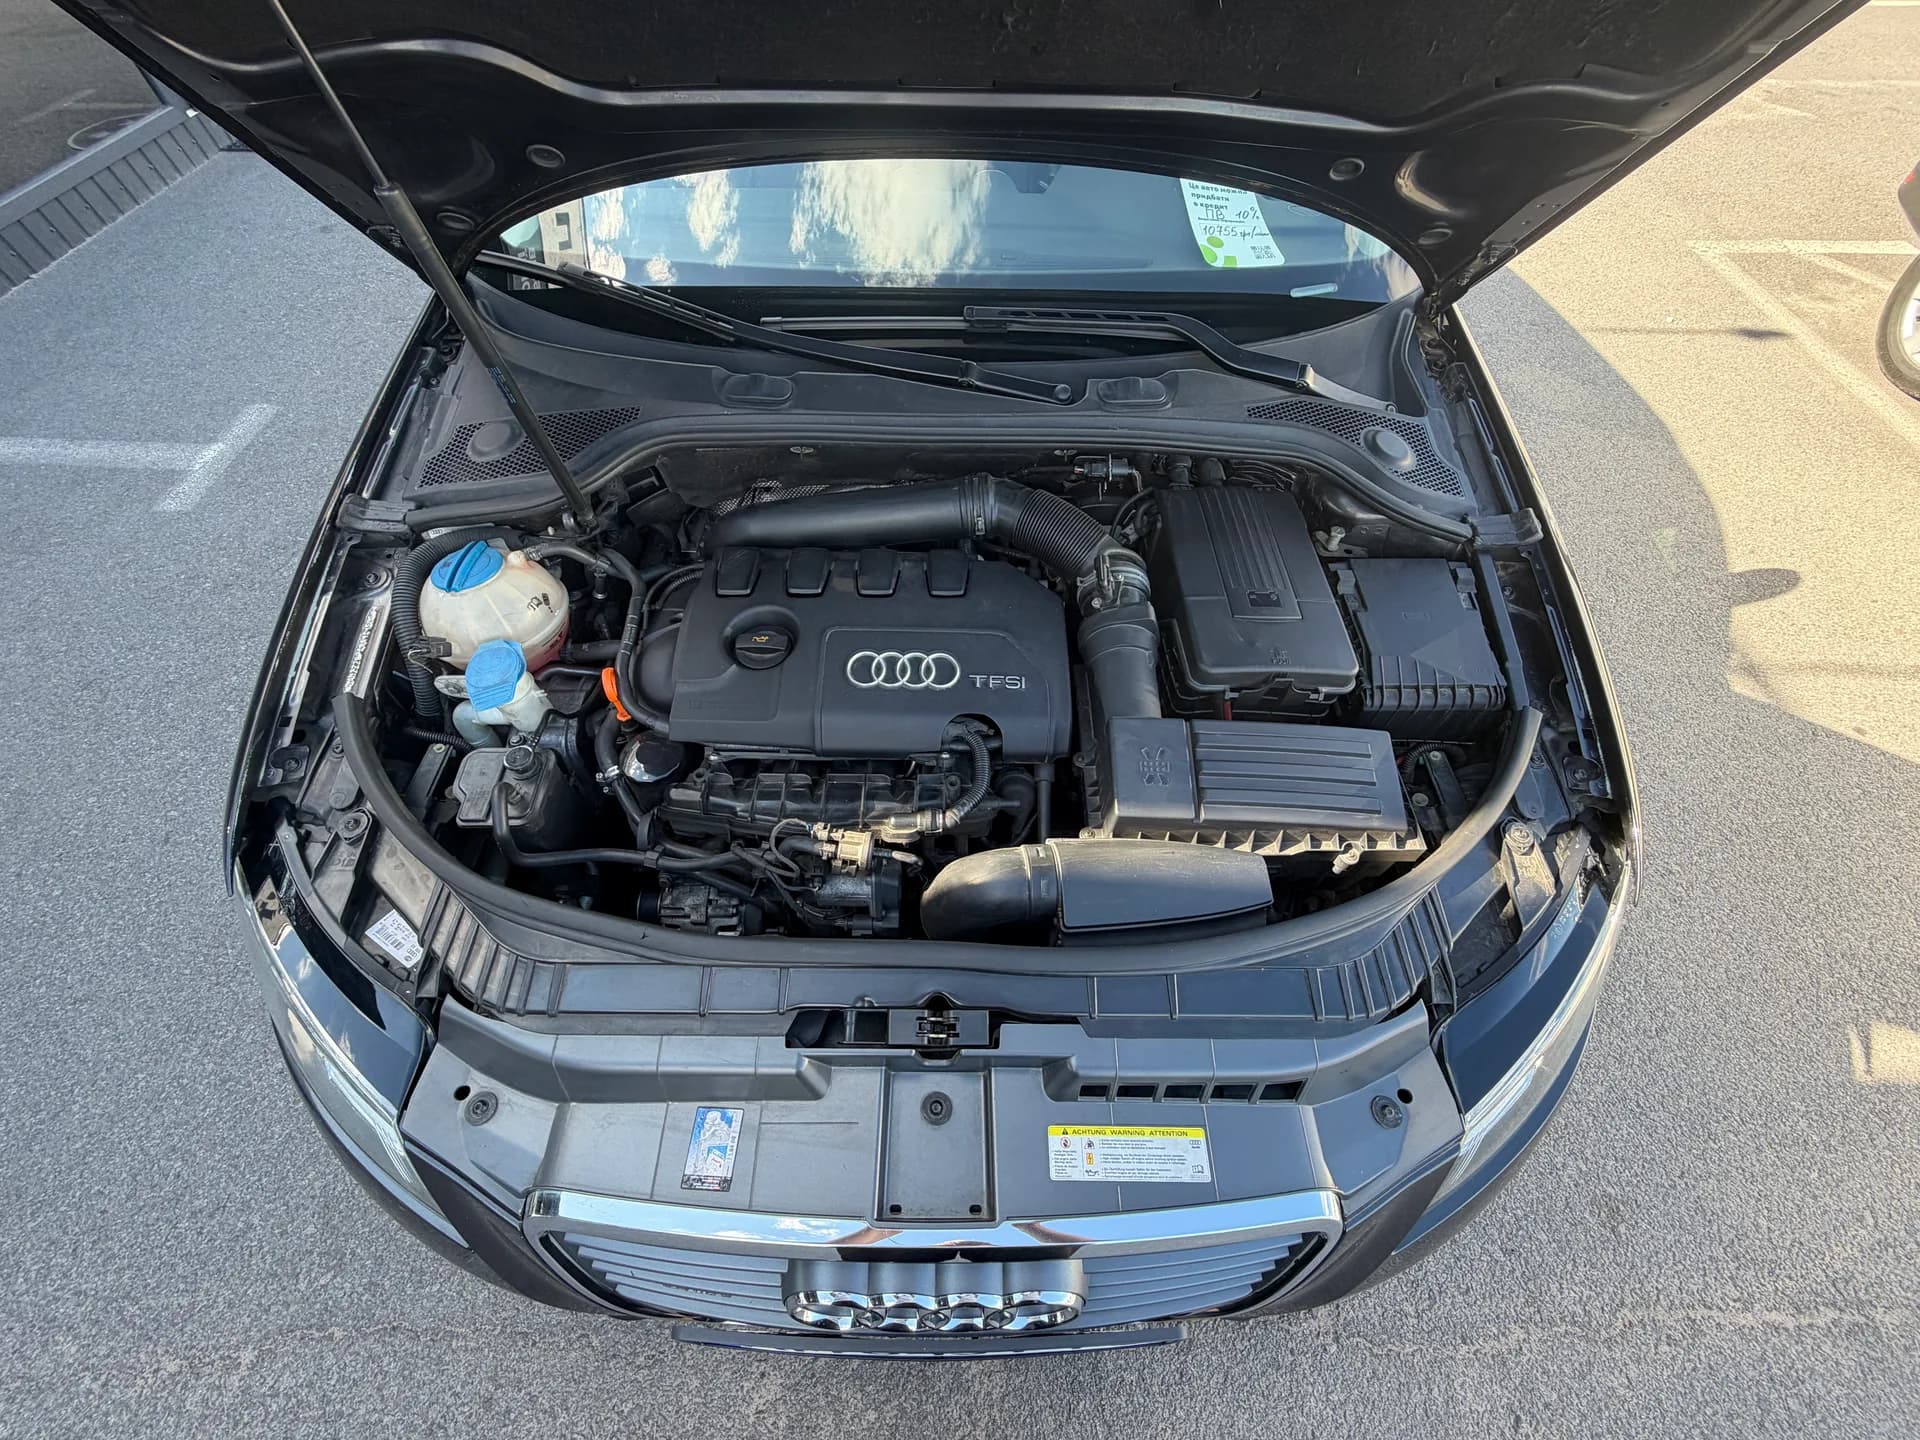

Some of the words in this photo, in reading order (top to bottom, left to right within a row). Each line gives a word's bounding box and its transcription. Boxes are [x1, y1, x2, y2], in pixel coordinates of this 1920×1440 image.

[1191, 192, 1230, 201] придбати
[1200, 202, 1228, 210] кредит
[1206, 208, 1225, 220] ПВ
[1235, 206, 1260, 220] 10%
[1203, 225, 1238, 236] 10755
[968, 674, 1026, 689] TFSI
[1072, 1127, 1107, 1136] ACHTUNG
[1110, 1127, 1146, 1137] WARNING
[1149, 1128, 1188, 1137] ATTENTION
